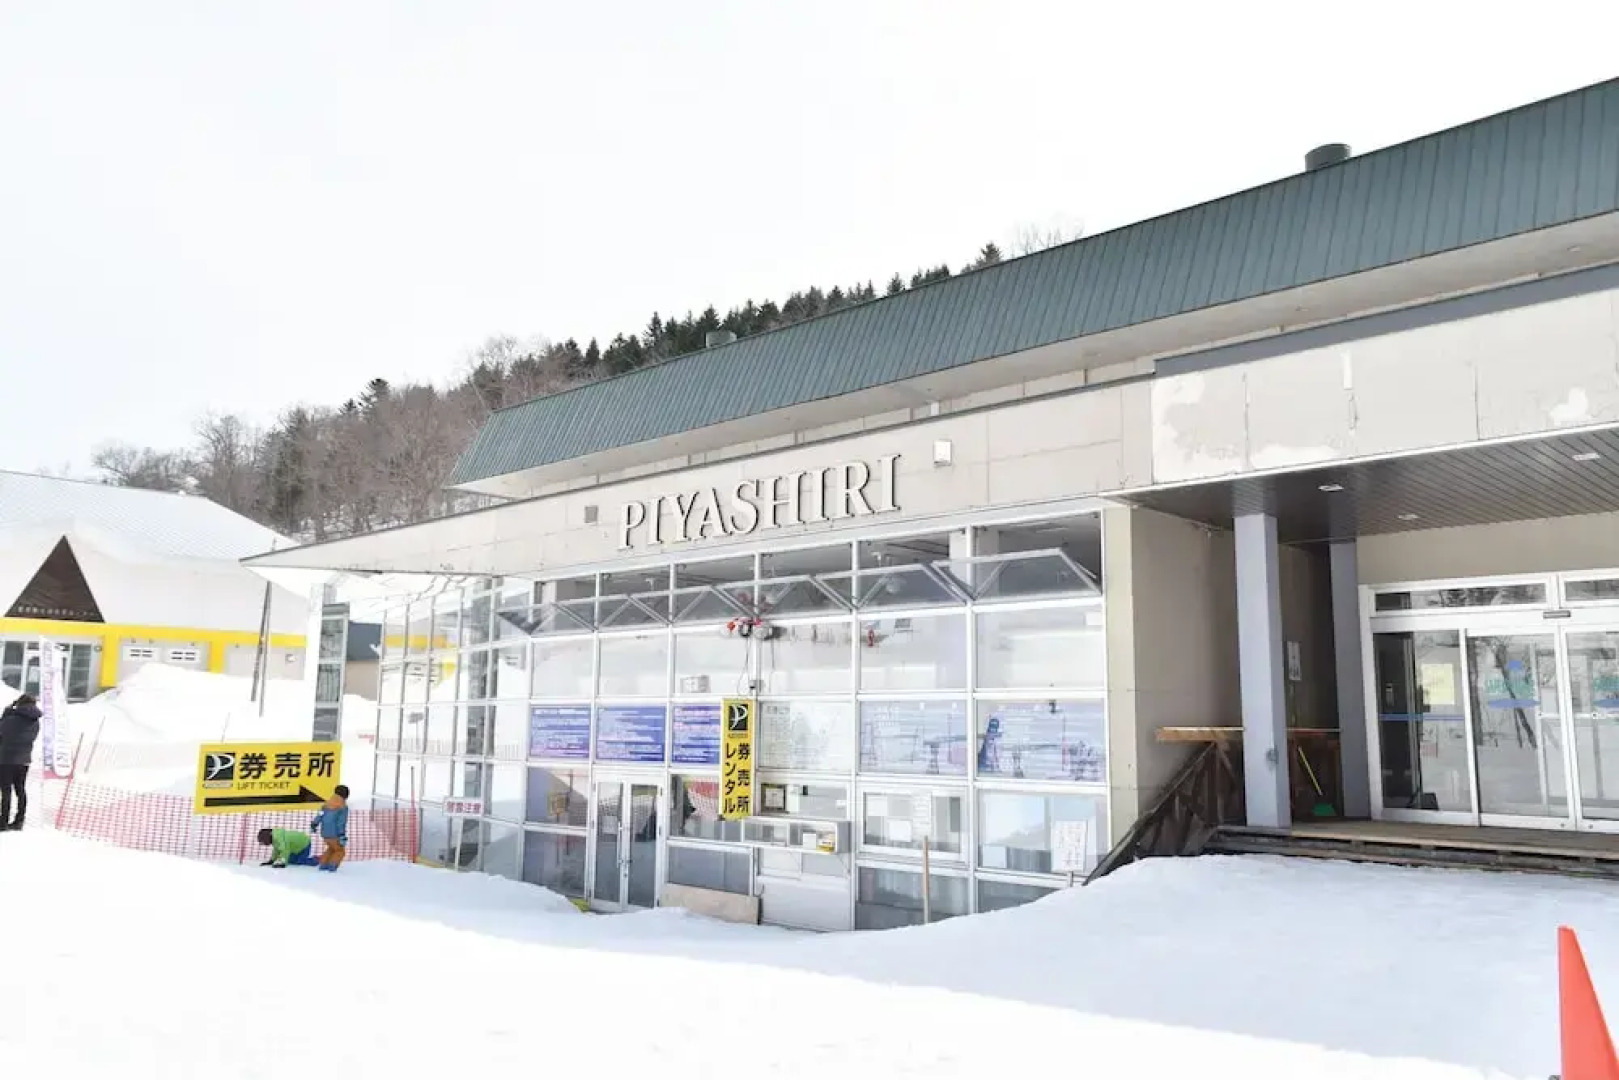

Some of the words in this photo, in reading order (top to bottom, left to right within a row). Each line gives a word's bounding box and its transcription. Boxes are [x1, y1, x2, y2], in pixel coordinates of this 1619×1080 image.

[618, 454, 902, 550] PIYASHIRI
[237, 782, 256, 791] LIFT
[259, 781, 291, 790] TICKET
[239, 752, 335, 779] 券売所
[724, 742, 737, 813] レンタル
[737, 742, 750, 813] 券売所
